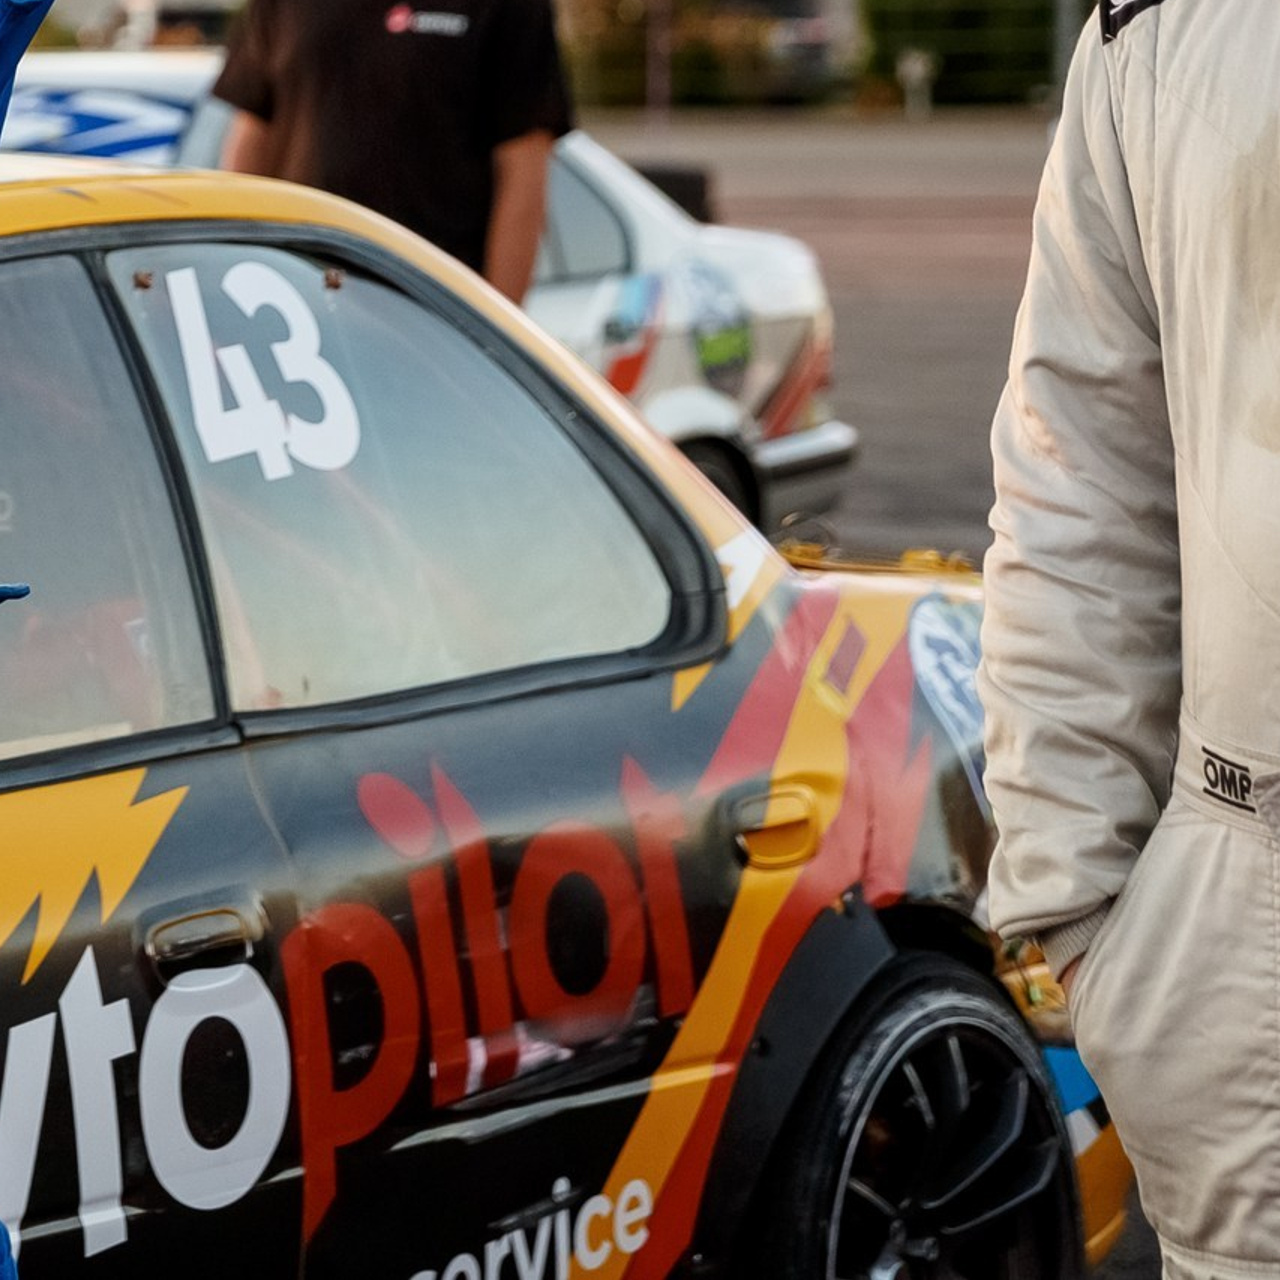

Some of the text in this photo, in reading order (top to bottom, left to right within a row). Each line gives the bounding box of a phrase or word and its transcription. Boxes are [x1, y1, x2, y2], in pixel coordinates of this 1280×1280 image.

[166, 261, 360, 481] 43
[1203, 757, 1252, 802] OMP
[408, 1176, 654, 1280] rvice
